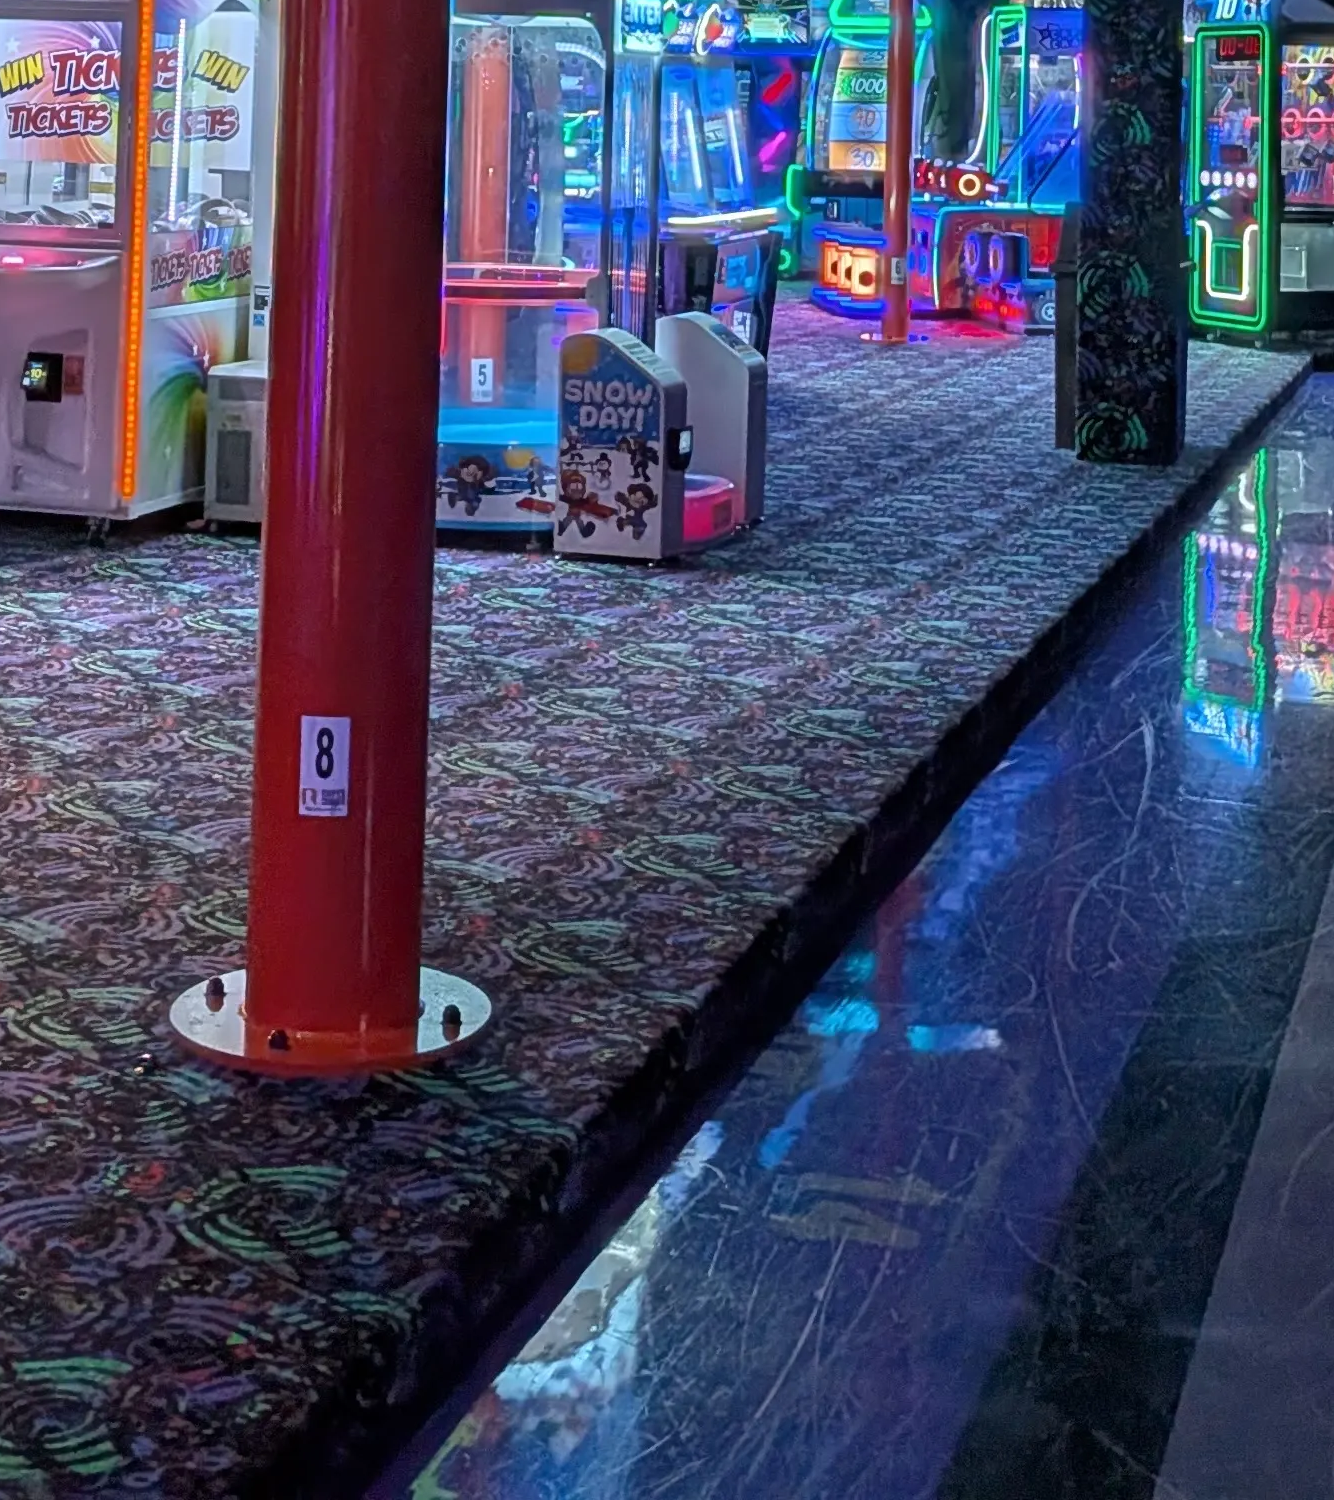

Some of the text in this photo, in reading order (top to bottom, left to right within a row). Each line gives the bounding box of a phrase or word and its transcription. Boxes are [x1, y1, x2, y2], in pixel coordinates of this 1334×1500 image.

[191, 50, 250, 94] WIN
[849, 79, 886, 94] 1000
[6, 101, 112, 138] TICKETS
[851, 147, 875, 168] 30
[477, 364, 488, 386] 5
[564, 379, 653, 406] SNOW
[579, 405, 645, 432] DAY!
[315, 727, 334, 779] 8
